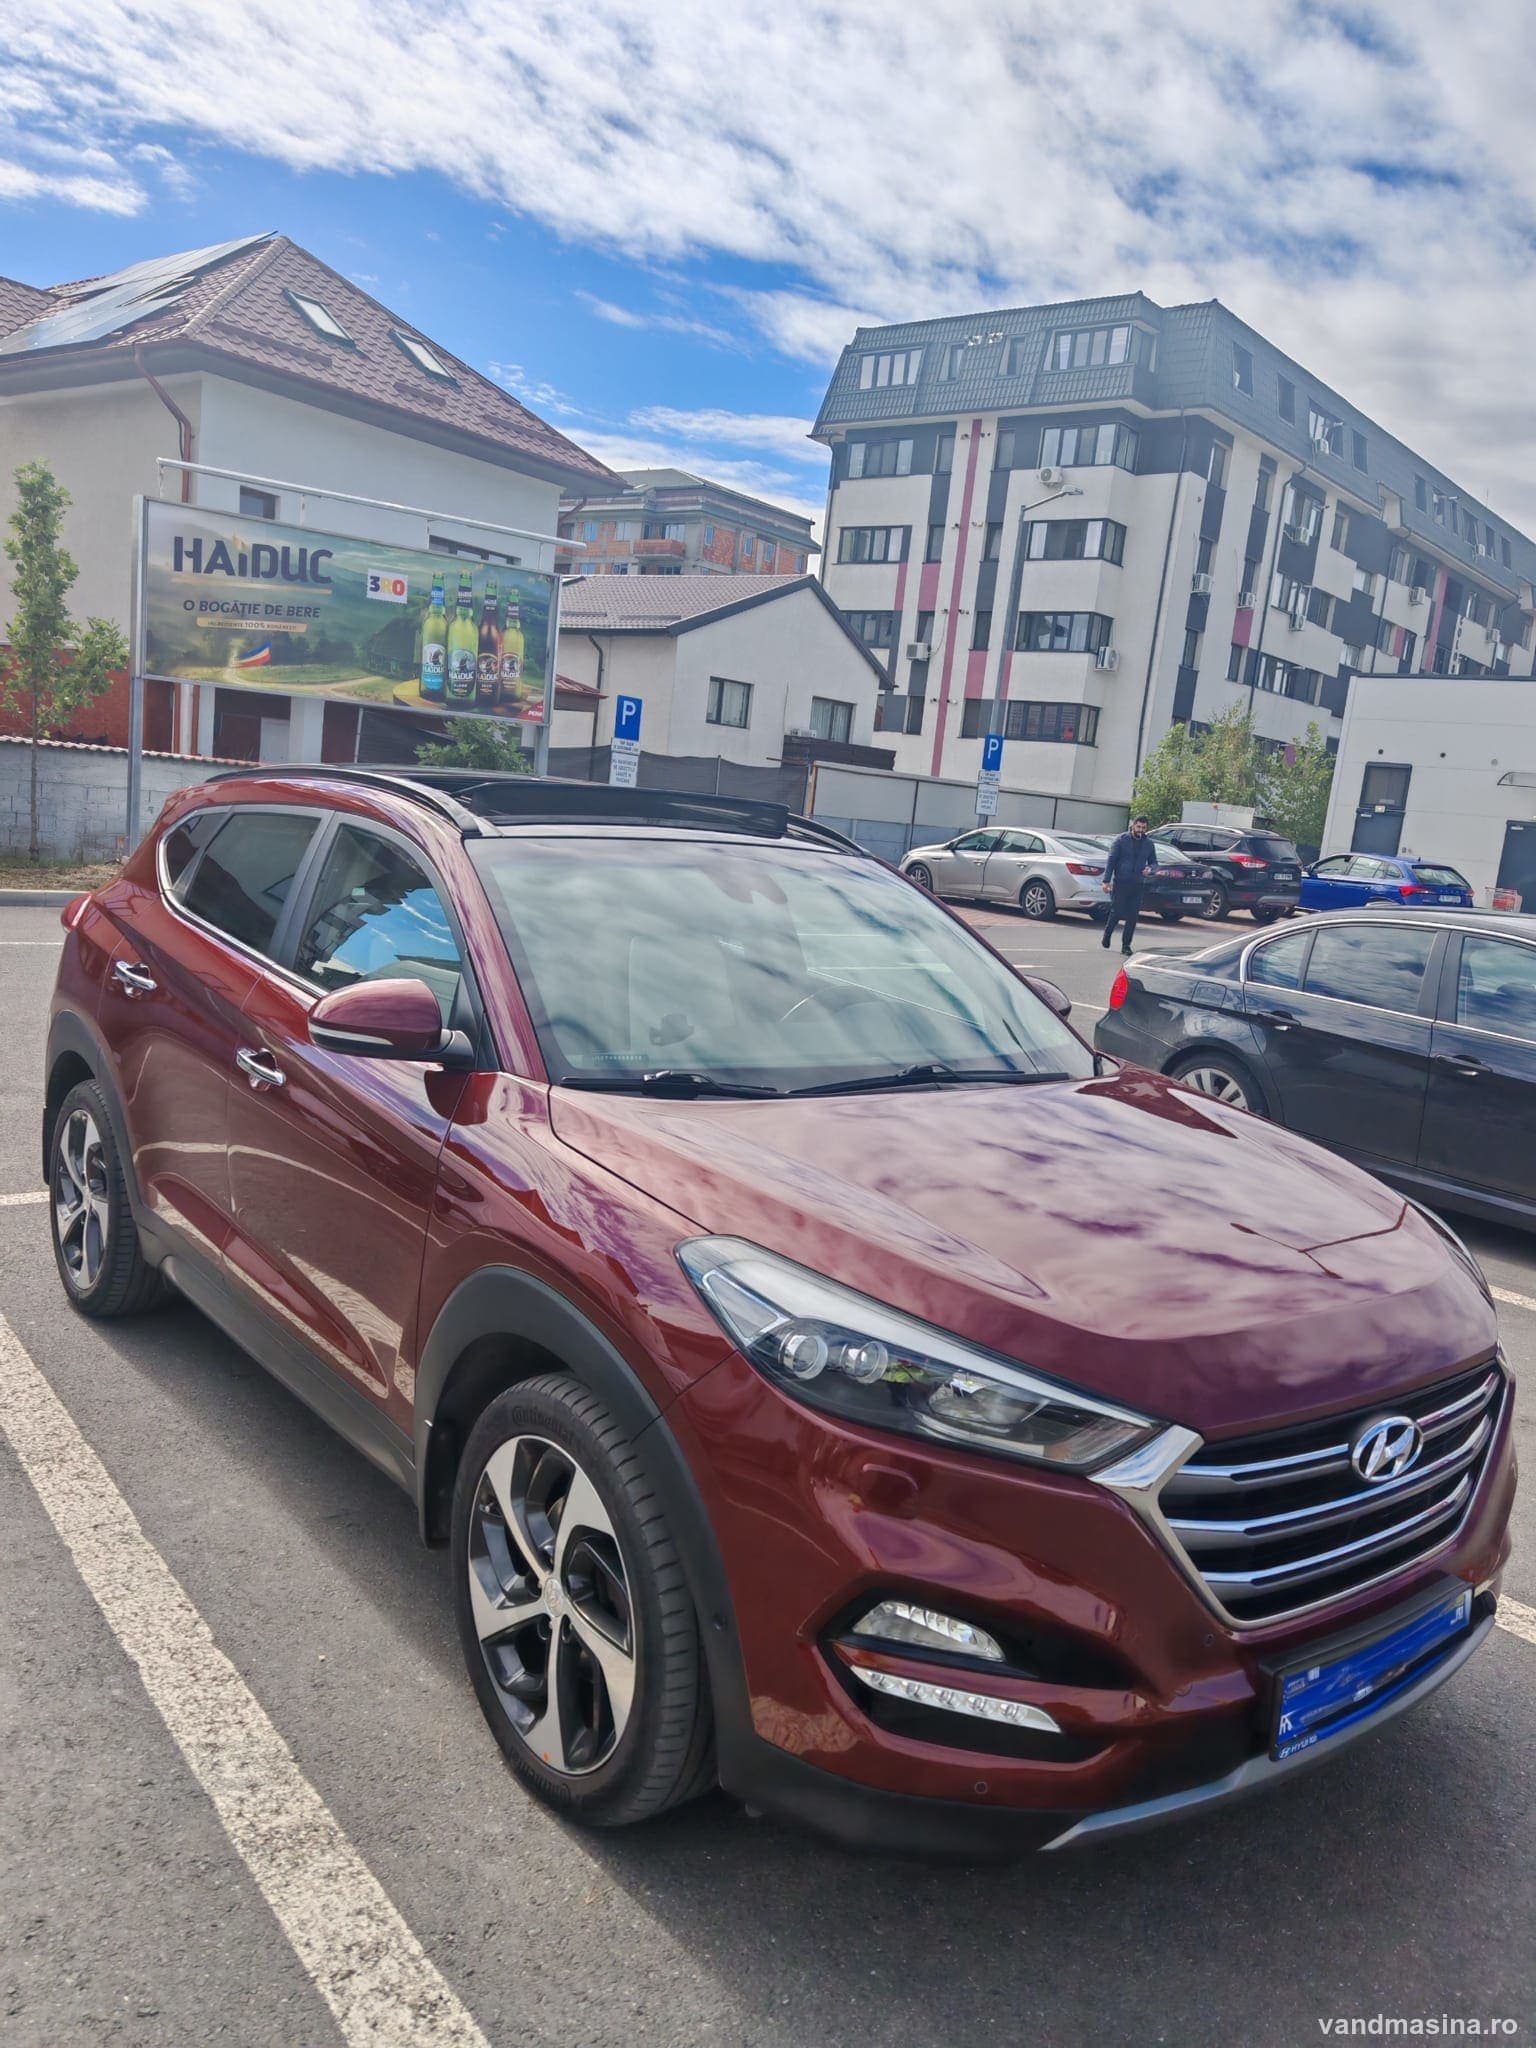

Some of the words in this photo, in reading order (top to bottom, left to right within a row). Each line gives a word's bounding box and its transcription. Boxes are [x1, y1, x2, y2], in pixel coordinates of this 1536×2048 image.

[369, 575, 405, 596] 3RO
[183, 600, 195, 611] O
[264, 604, 282, 616] DE
[286, 606, 321, 618] BERE
[621, 700, 636, 725] P
[987, 738, 999, 759] P
